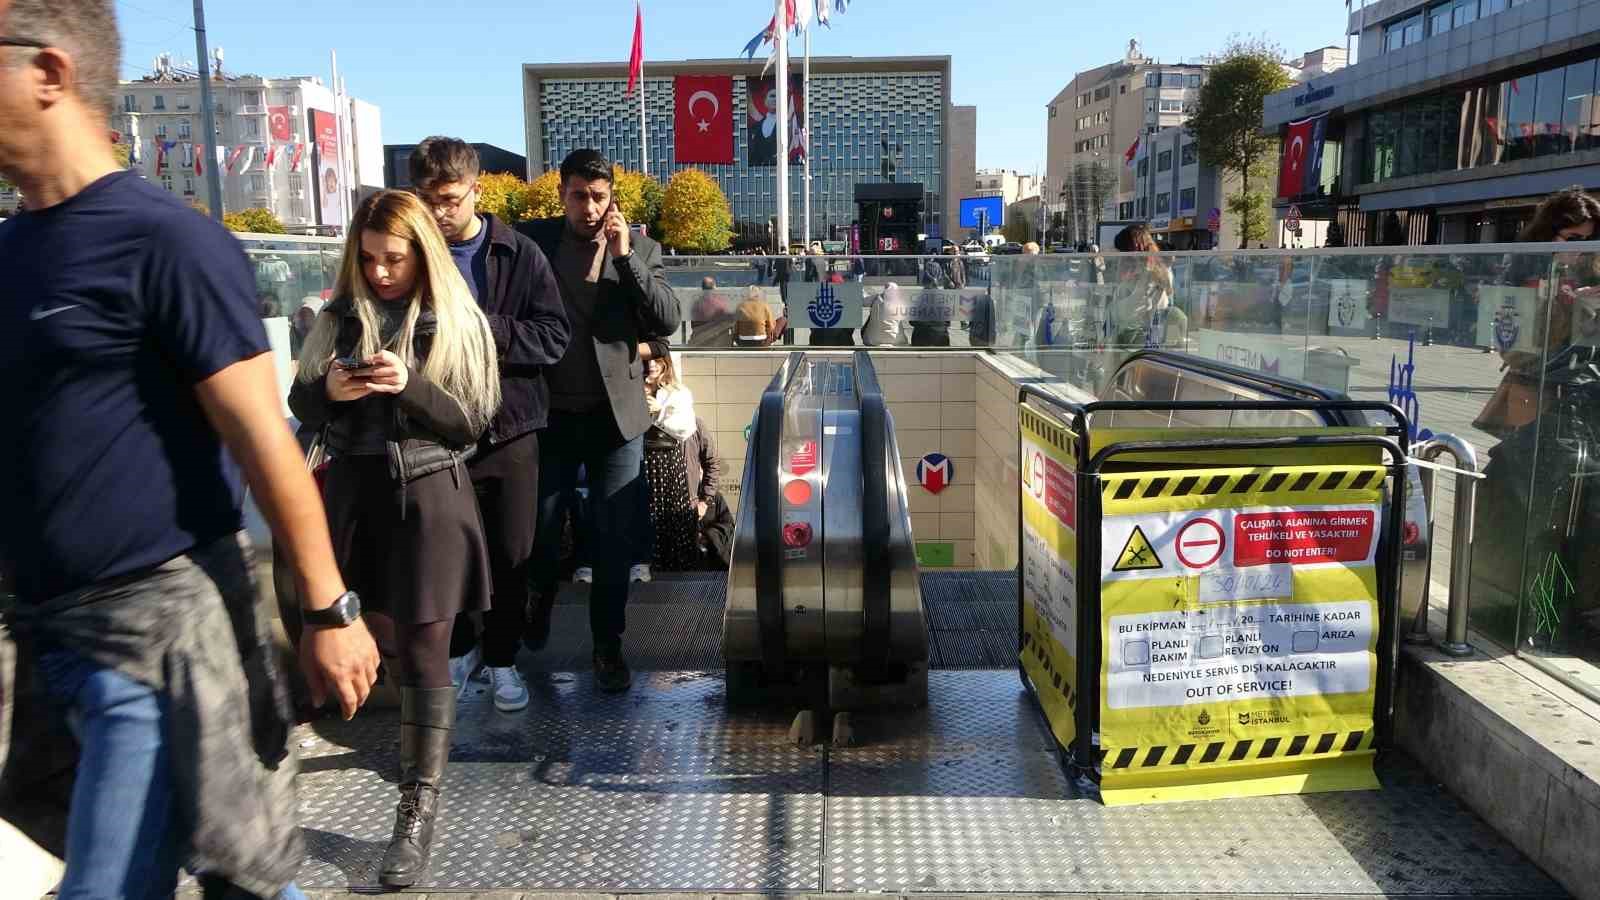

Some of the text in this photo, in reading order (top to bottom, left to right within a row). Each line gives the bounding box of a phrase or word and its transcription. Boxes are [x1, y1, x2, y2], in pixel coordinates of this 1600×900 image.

[1240, 516, 1368, 530] ÇALIŞMA ALANINA GİRMEK
[1248, 529, 1359, 541] TEHLİKELİ VE YASAKTIR!
[1265, 547, 1337, 558] DO NOT ENTER!
[1119, 625, 1133, 634] BU
[1136, 621, 1186, 632] EKİPMAN
[1269, 612, 1321, 624] TARİHİNE
[1323, 611, 1361, 621] KADAR
[1225, 632, 1261, 644] PLANLI
[1321, 630, 1356, 640] ARIZA
[1151, 640, 1189, 650] PLANLI
[1225, 644, 1280, 656] REVİZYON
[1152, 652, 1188, 663] BAKIM
[1242, 663, 1263, 674] DIŞI
[1266, 660, 1337, 672] KALACAKTIR
[1186, 680, 1293, 698] OUT OF SERVICE!
